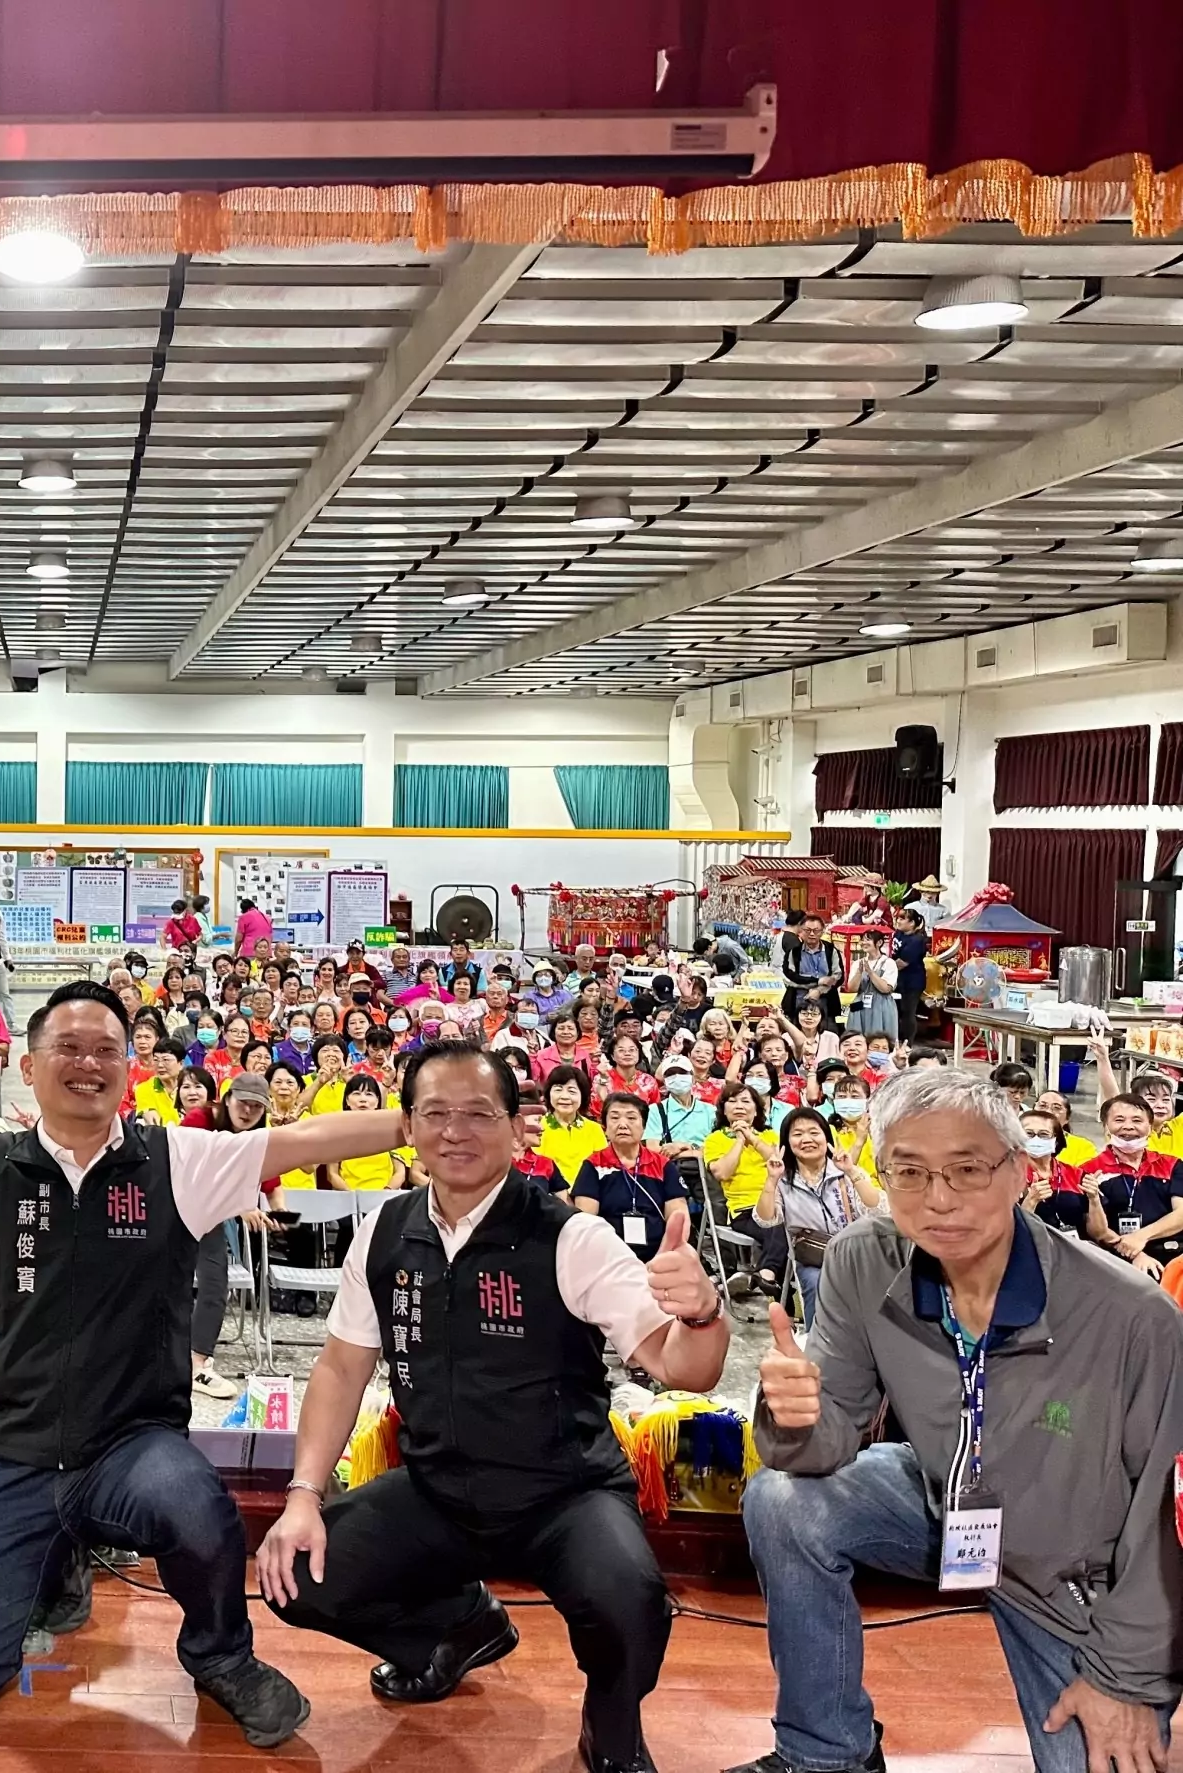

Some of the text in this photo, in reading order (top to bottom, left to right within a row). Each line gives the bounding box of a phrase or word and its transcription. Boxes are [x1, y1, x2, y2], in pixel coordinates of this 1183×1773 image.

[367, 932, 395, 942] 反詐騙
[38, 1183, 50, 1231] 副市長
[16, 1199, 36, 1293] 蘇俊賓
[107, 1228, 147, 1236] 桃園市政府
[410, 1271, 424, 1343] 社會局長
[480, 1322, 524, 1334] 桃園市政府
[392, 1289, 413, 1389] 陳寶民
